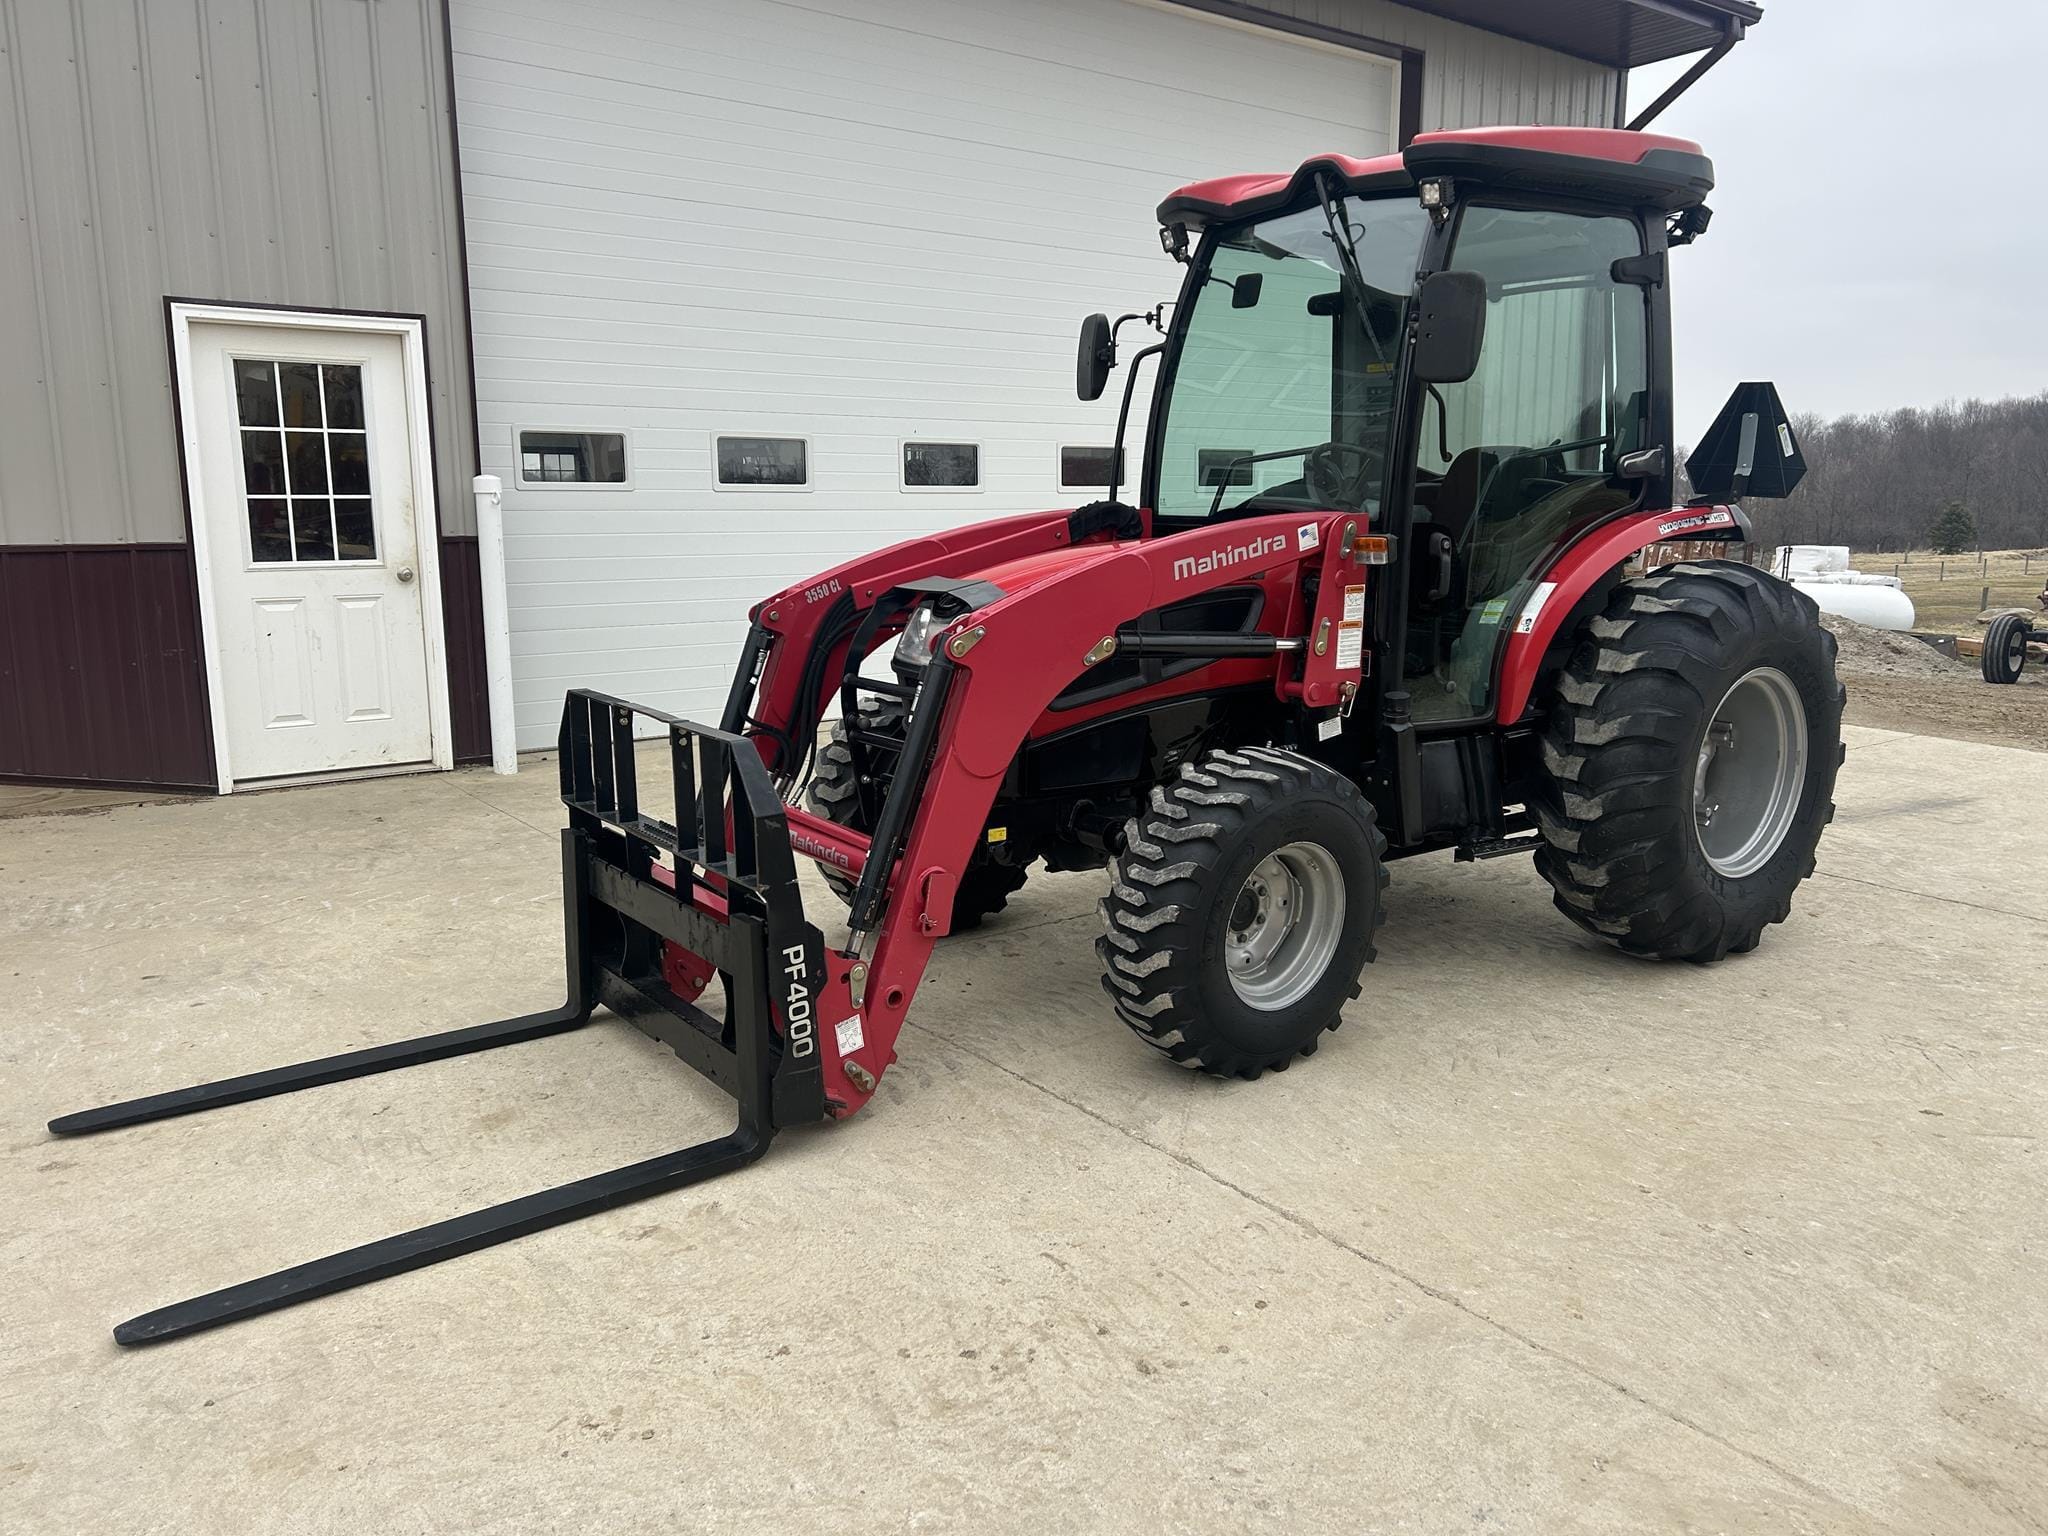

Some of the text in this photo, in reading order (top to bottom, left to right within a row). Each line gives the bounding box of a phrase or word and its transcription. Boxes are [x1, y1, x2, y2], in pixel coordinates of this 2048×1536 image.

[1713, 513, 1726, 521] HST
[1173, 535, 1286, 580] Mahindra
[805, 579, 842, 603] 3550 CL
[782, 944, 814, 1058] PF4000
